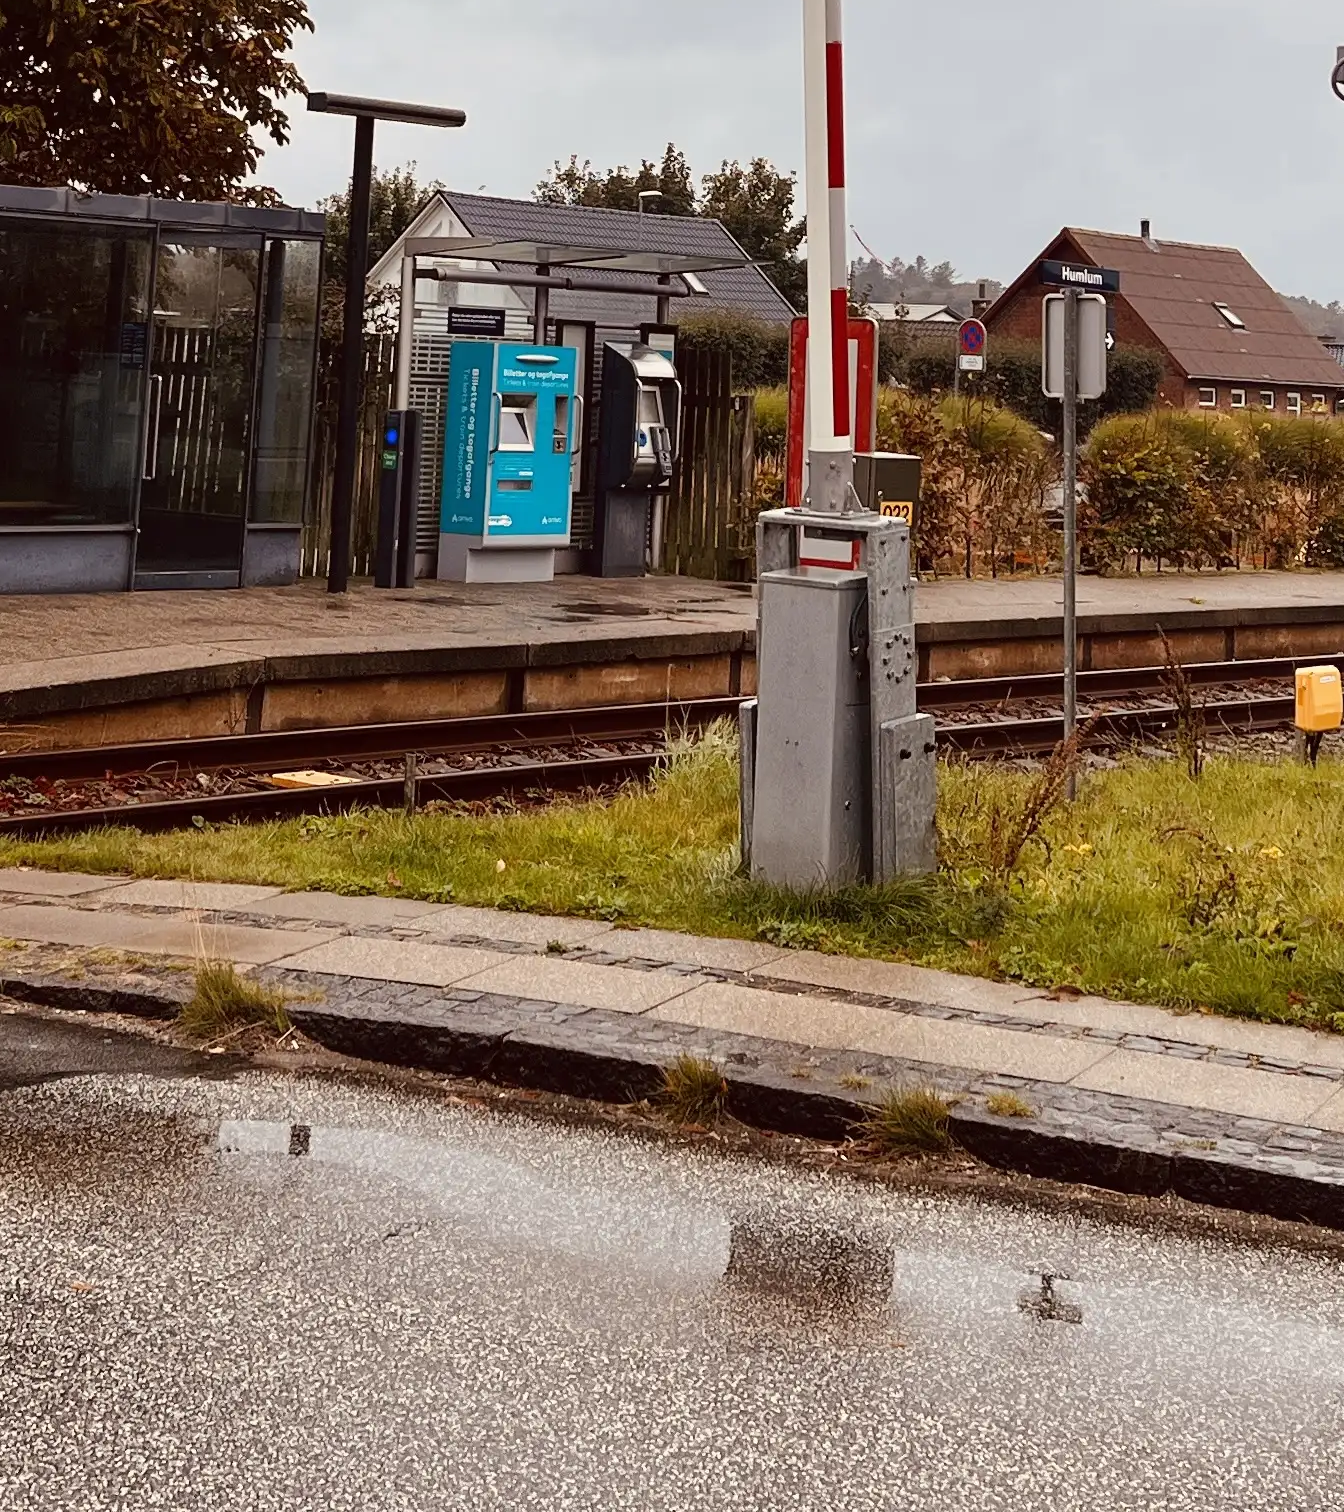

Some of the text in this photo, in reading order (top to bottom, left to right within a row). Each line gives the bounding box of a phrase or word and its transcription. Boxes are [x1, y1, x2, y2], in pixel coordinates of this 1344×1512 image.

[1062, 266, 1103, 285] Humlum
[461, 368, 470, 403] Tickets
[463, 368, 480, 499] Billetter og togafgange
[455, 442, 465, 499] departures
